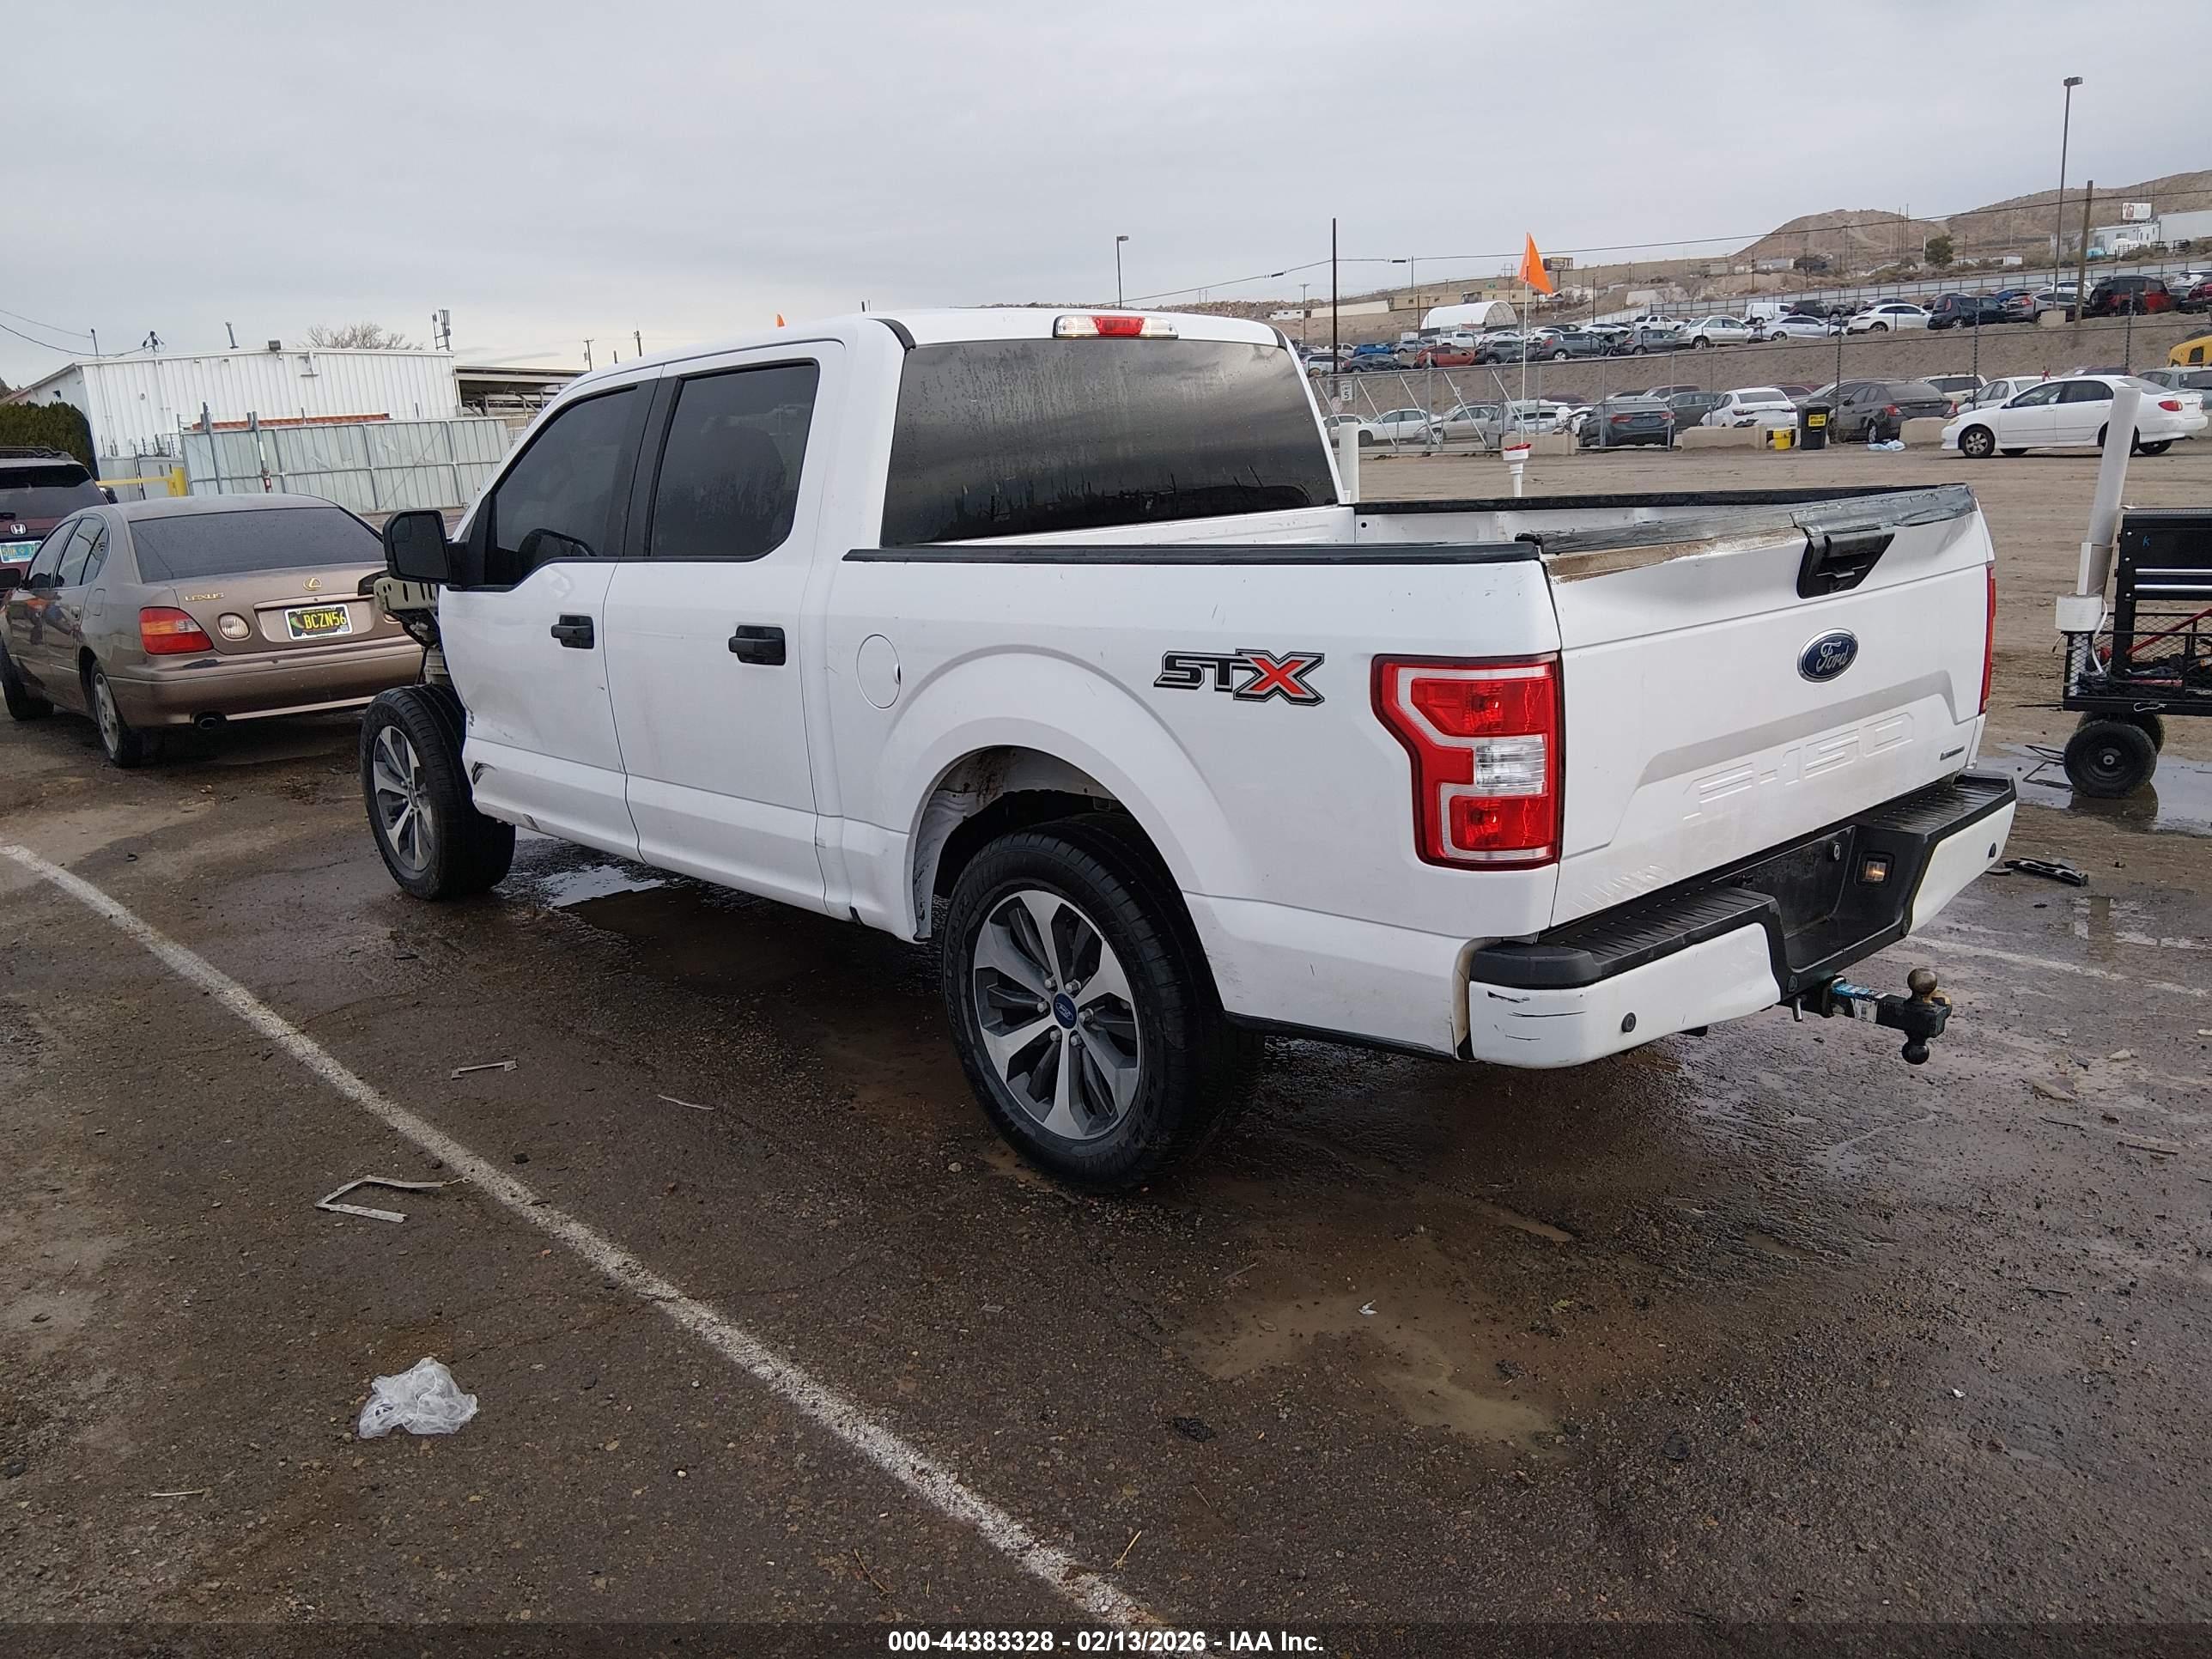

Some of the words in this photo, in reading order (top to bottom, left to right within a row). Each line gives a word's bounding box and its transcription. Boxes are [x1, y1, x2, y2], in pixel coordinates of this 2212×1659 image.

[1344, 391, 1350, 399] 5
[303, 611, 347, 629] BCZN56
[1816, 640, 1850, 673] Ford
[1154, 648, 1325, 707] STX
[1683, 712, 1915, 821] F-150
